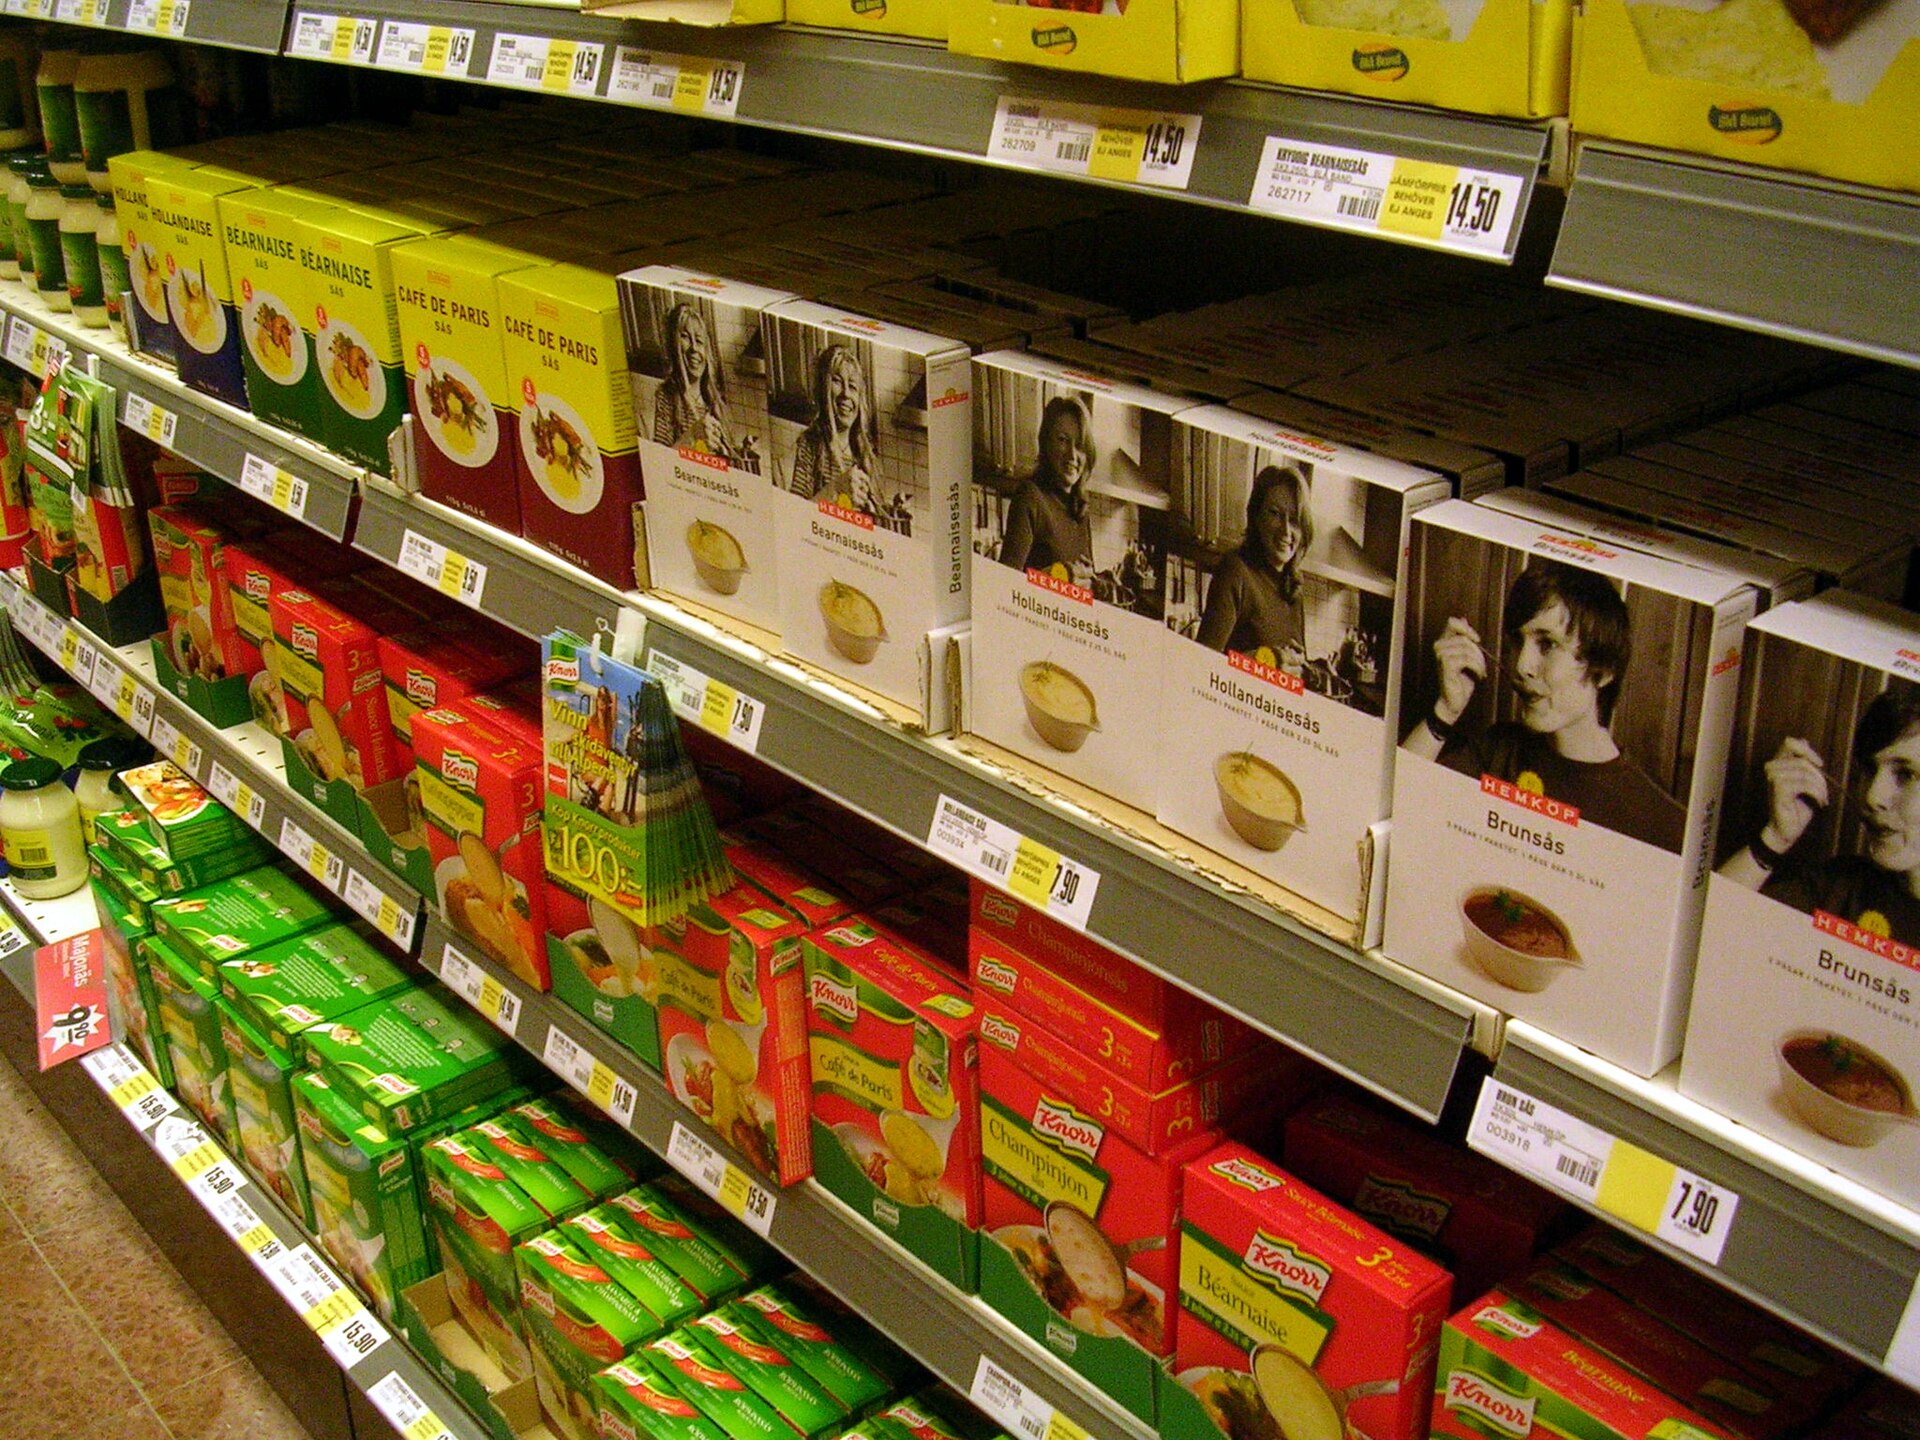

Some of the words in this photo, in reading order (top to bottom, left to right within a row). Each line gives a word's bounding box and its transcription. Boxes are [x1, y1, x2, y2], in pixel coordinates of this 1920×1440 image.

[1001, 137, 1036, 152] 262709
[1142, 123, 1185, 165] 14.50
[1267, 186, 1311, 203] 262717
[1391, 174, 1446, 195] JÄMFÖRPRIS
[1393, 191, 1435, 206] BEHÖVER
[151, 206, 213, 237] HOLLANDAISE
[1389, 202, 1400, 213] EJ
[1402, 206, 1434, 220] ANGES
[1446, 182, 1501, 233] 14.50
[226, 223, 295, 261] BÉARNAISE
[300, 246, 373, 289] BÉARNAISE
[399, 286, 427, 310] CAFÉ
[430, 297, 448, 316] DE
[451, 302, 490, 328] PARIS
[434, 320, 452, 335] SÅS
[505, 315, 534, 342] CAFÉ
[538, 328, 556, 351] DE
[559, 335, 599, 366] PARIS
[541, 355, 560, 371] SÅS
[674, 466, 740, 498] Bearnaisesås
[811, 521, 884, 560] Bearnaisesås
[949, 481, 961, 594] Bearnaisesås
[1012, 590, 1109, 640] Hollandaisesås
[547, 661, 578, 678] Knorr
[548, 699, 588, 731] Vinn
[1210, 672, 1320, 734] Hollandaisesås
[570, 748, 616, 785] Alperna
[572, 731, 637, 778] skidäventyr
[1485, 779, 1575, 820] HEMKÖP
[1487, 810, 1566, 855] Brunsås
[1049, 864, 1080, 904] 7.90
[70, 934, 93, 987] Majonäs
[980, 965, 1016, 988] Knorr
[1817, 949, 1910, 1004] Brunsås
[813, 980, 857, 1015] Knorr
[983, 1023, 1018, 1044] Knorr
[1098, 1027, 1115, 1057] 3
[820, 1054, 843, 1076] Café
[848, 1069, 860, 1080] de
[860, 1076, 892, 1101] Paris
[1098, 1086, 1114, 1116] 3
[1038, 1107, 1097, 1149] Knorr
[1486, 1121, 1531, 1152] 003918
[989, 1118, 1089, 1201] Champinjon
[1671, 1180, 1719, 1235] 7.90
[1252, 1241, 1322, 1291] Knorr
[1356, 1246, 1393, 1267] 3
[1198, 1265, 1288, 1343] Béarnaise
[342, 1320, 379, 1354] 15,90
[1451, 1375, 1527, 1427] Knorr
